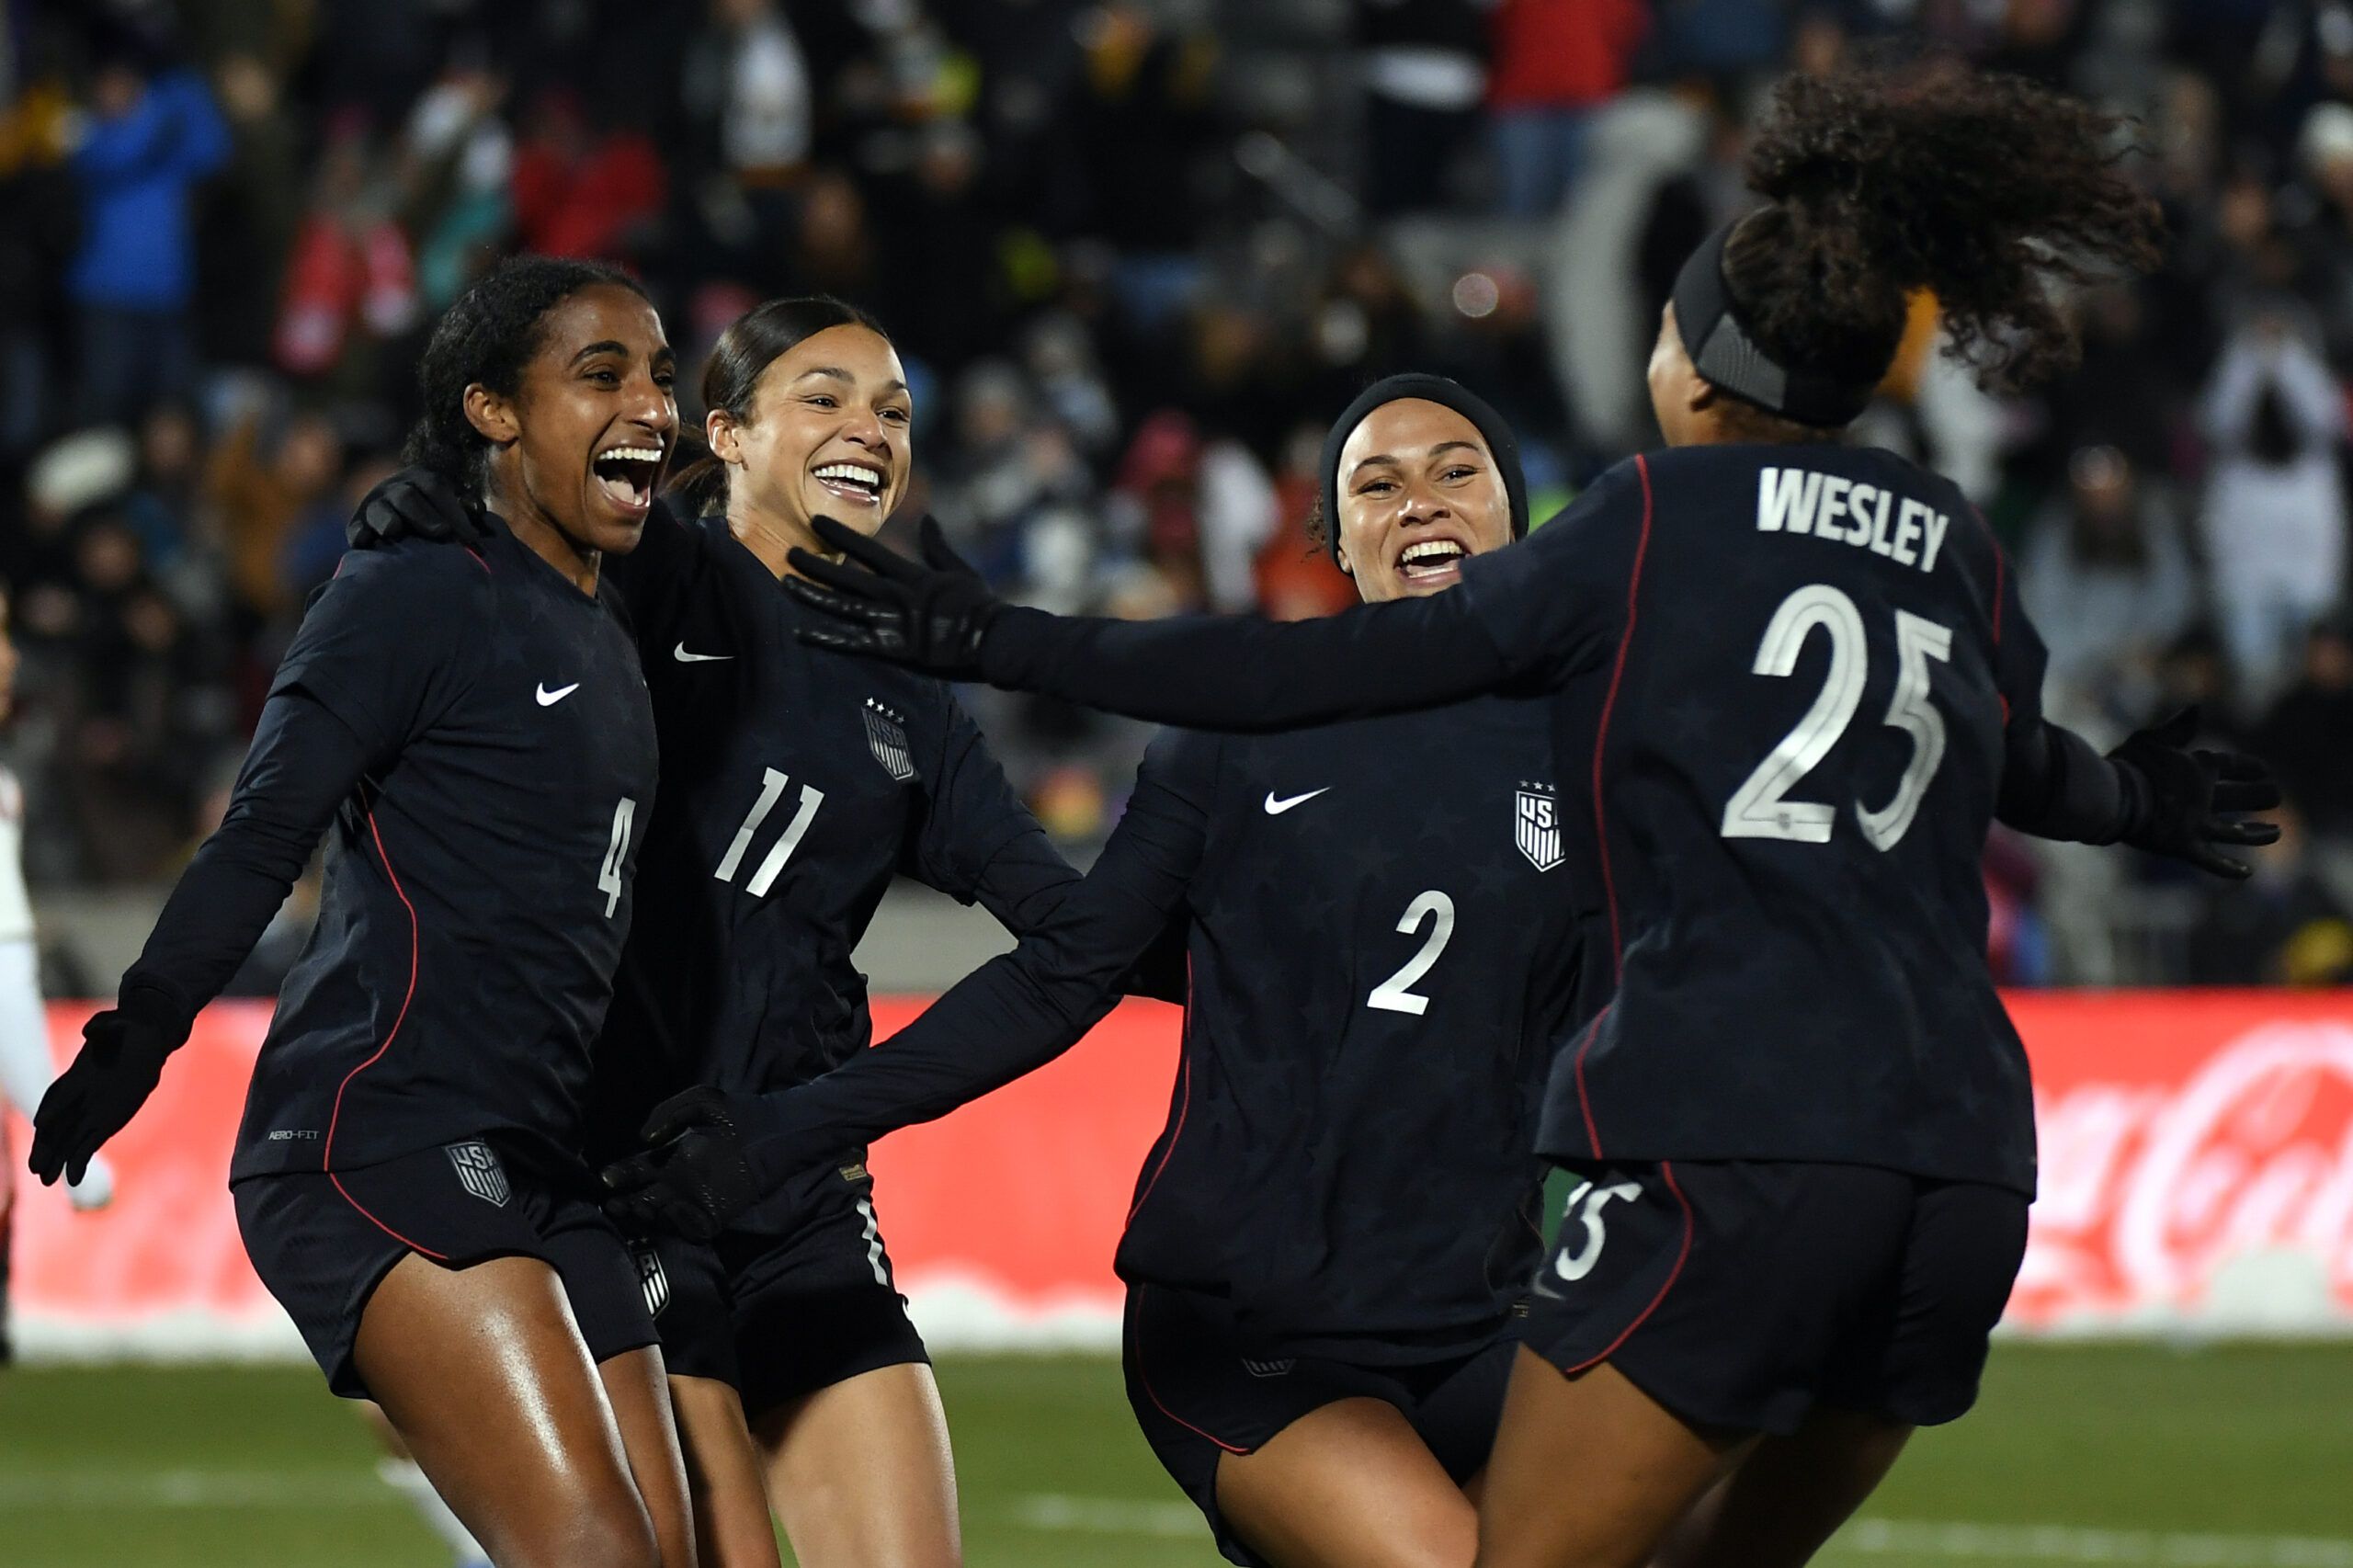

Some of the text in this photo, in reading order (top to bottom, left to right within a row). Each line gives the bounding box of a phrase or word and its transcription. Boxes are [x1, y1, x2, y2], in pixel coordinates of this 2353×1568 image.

[1756, 467, 1949, 574] WESLEY
[1721, 584, 1952, 852] 25
[597, 797, 636, 919] 4
[714, 767, 824, 898] 11
[1520, 796, 1558, 828] US
[1367, 890, 1455, 1016] 2
[268, 1131, 319, 1140] AERO-FIT
